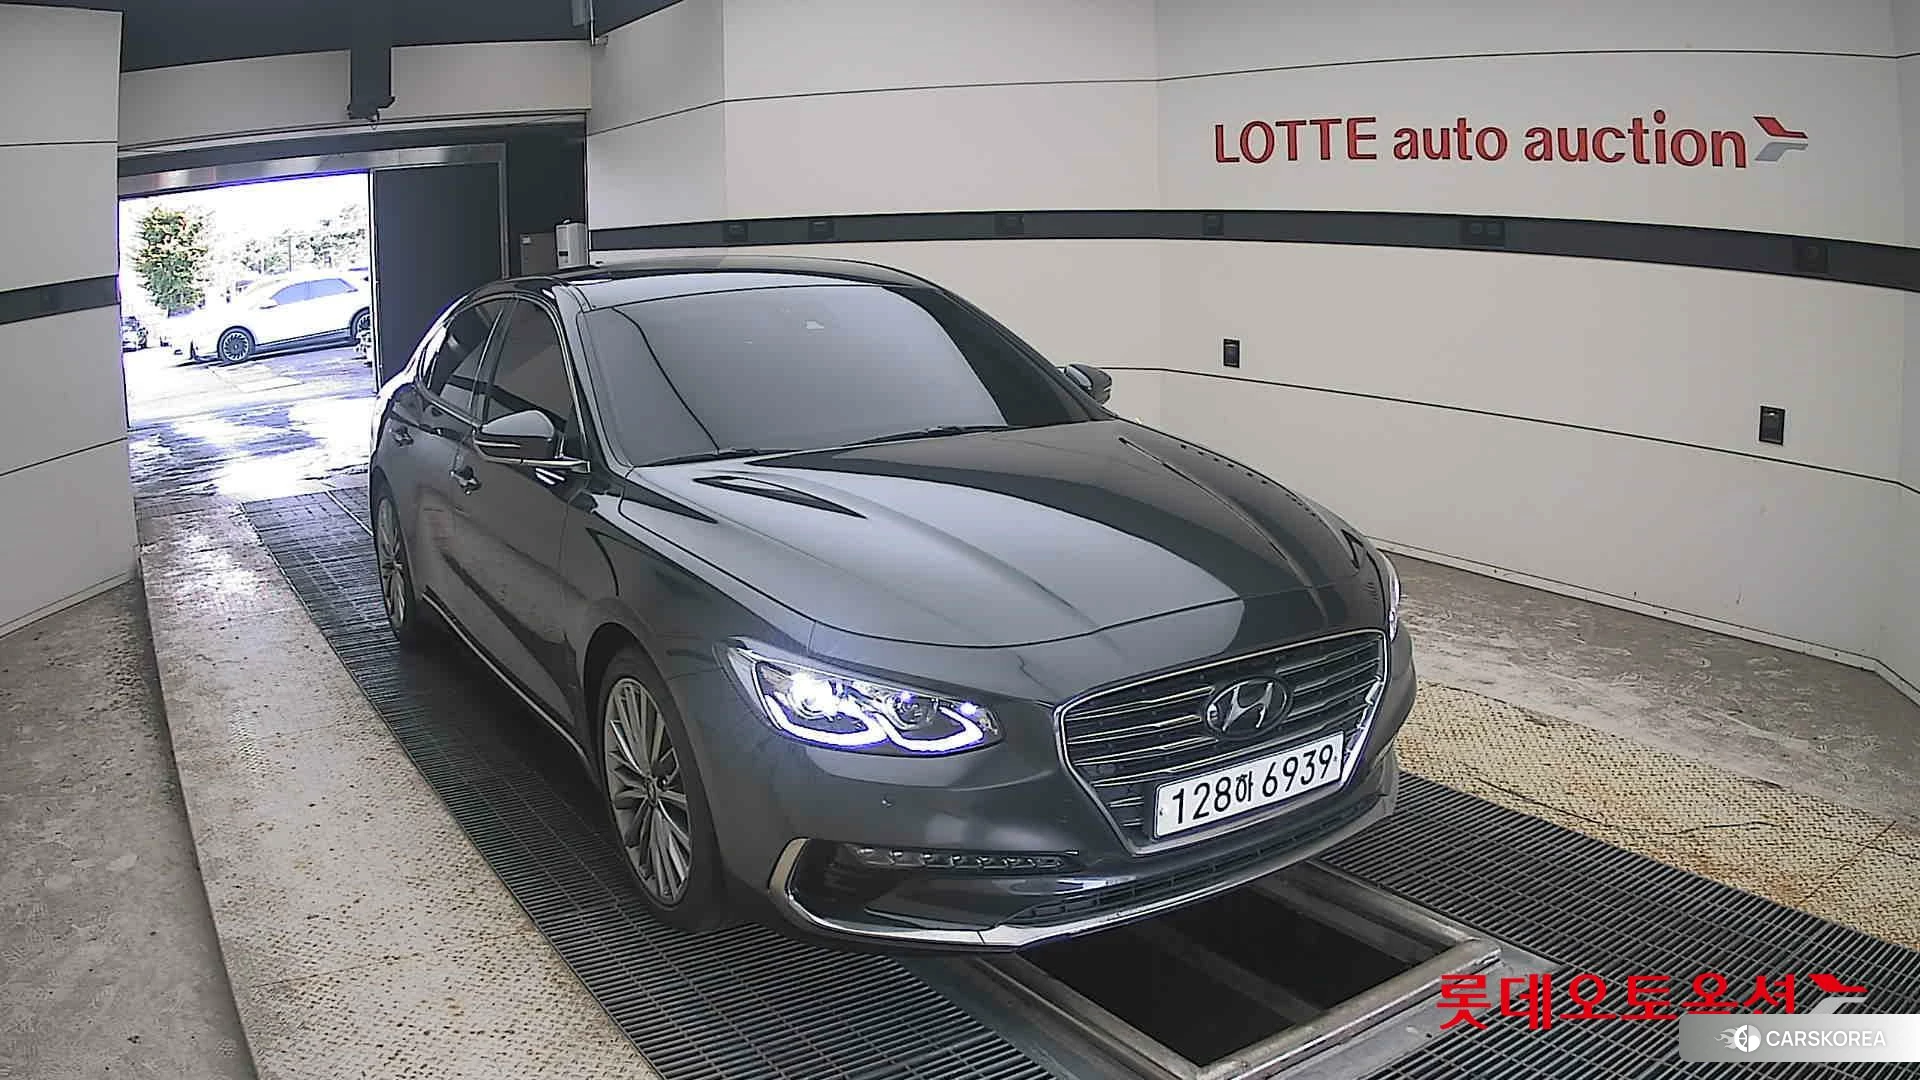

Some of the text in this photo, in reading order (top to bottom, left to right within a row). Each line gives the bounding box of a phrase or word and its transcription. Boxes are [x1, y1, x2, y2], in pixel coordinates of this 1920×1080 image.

[1214, 109, 1747, 168] LOTTE auto auction
[1172, 744, 1334, 824] 128하 6939
